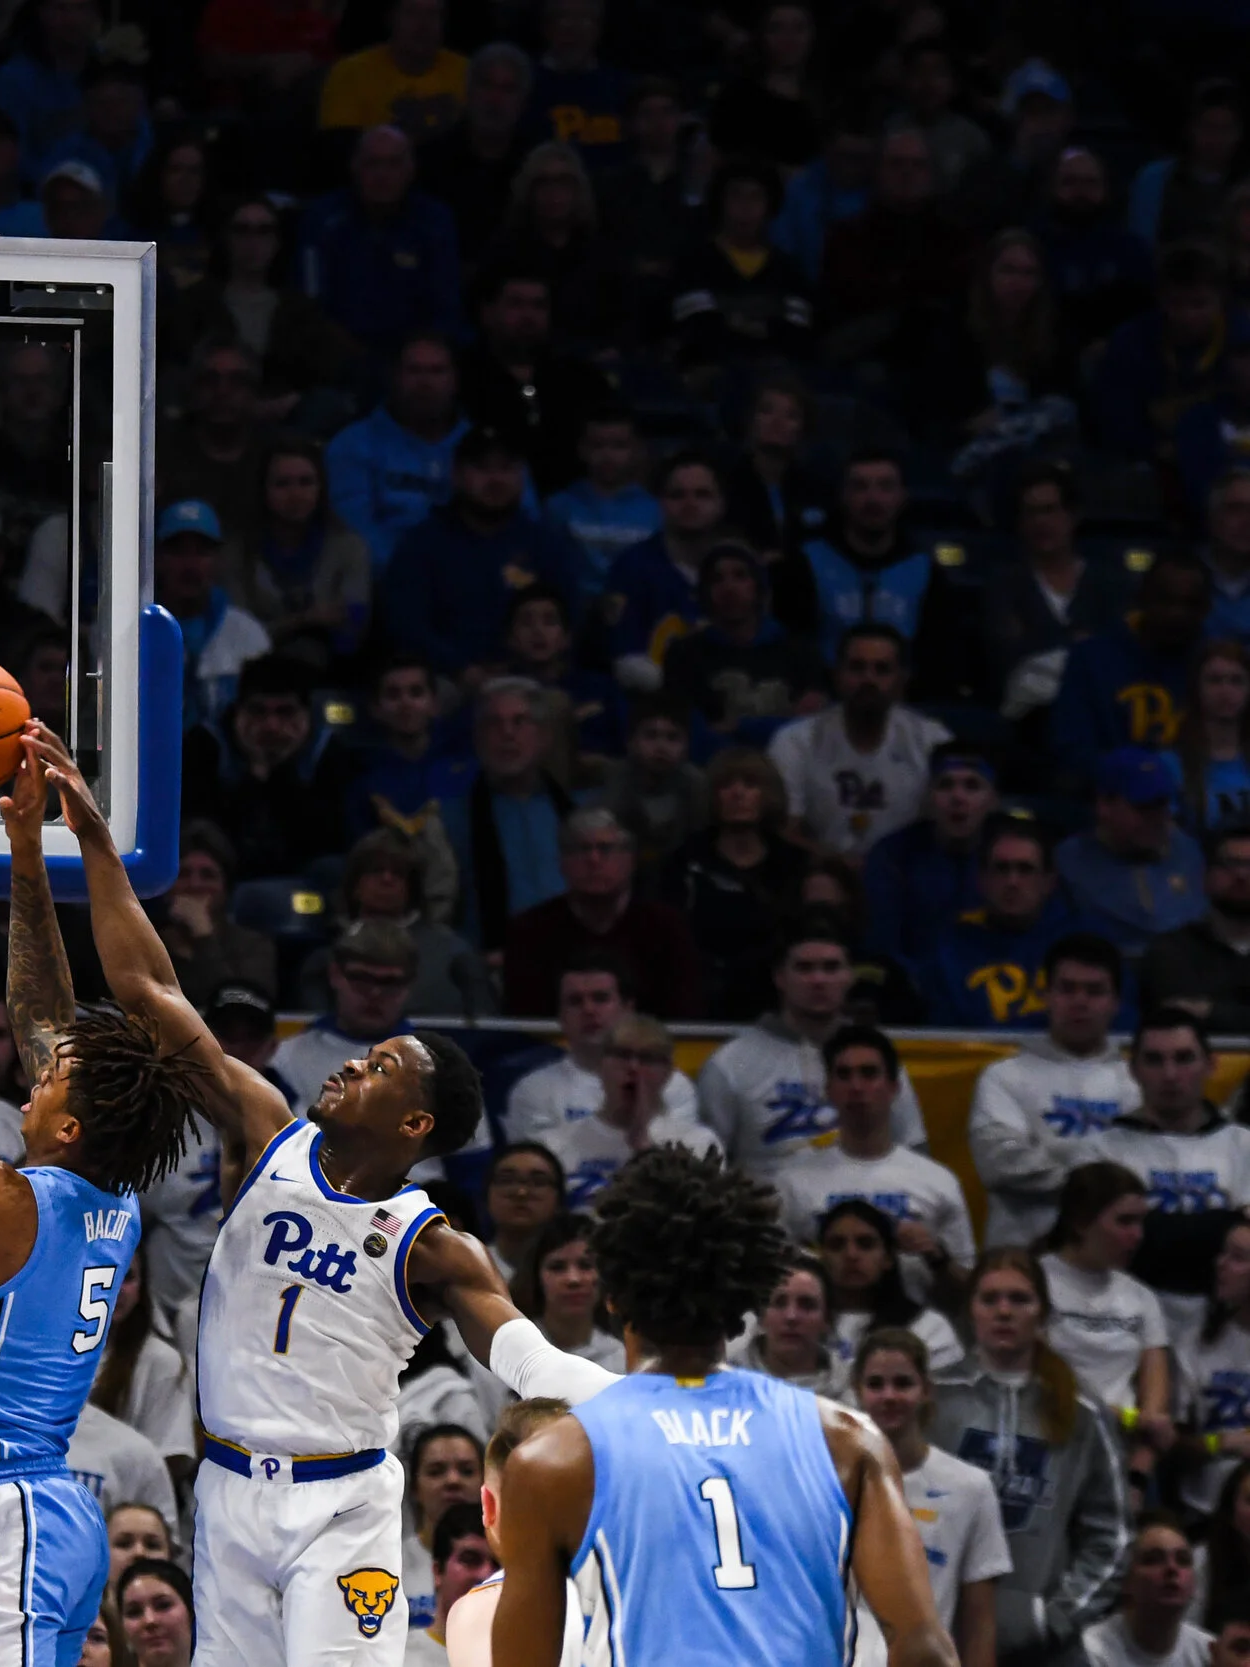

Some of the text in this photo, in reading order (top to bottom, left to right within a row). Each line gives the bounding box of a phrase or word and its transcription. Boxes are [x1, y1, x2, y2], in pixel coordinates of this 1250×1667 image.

[83, 1208, 132, 1243] BACOT
[262, 1210, 357, 1294] Pitt
[72, 1265, 118, 1355] 5
[272, 1283, 305, 1357] 1
[651, 1407, 754, 1447] BLACK
[260, 1457, 280, 1481] P
[698, 1476, 758, 1591] 1
